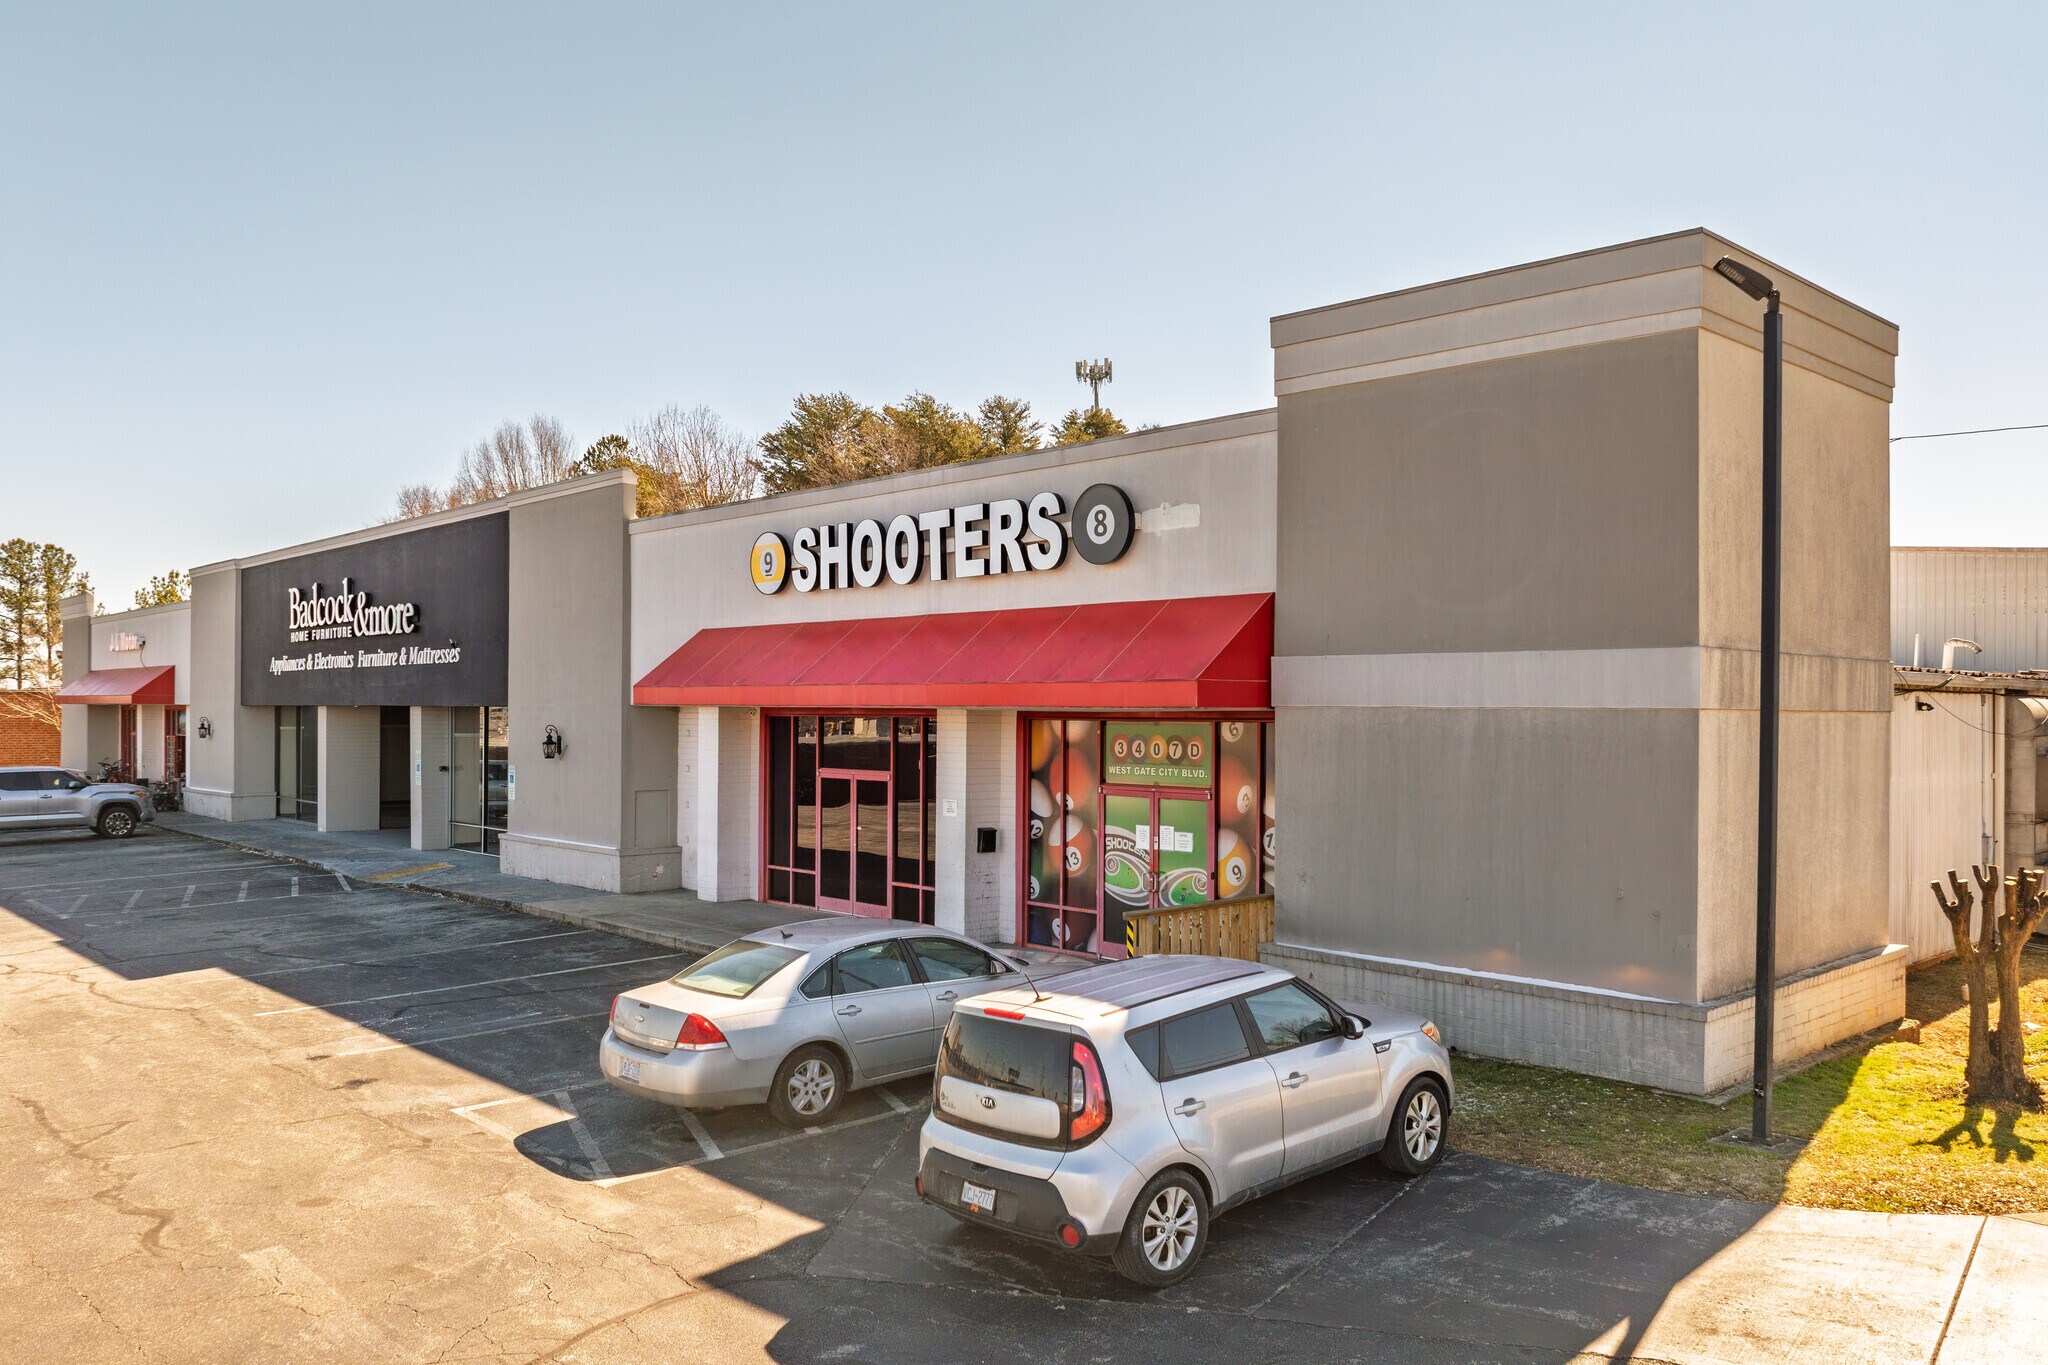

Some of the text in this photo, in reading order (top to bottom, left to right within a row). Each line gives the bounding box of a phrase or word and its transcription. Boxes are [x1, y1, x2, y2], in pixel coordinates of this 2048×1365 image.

[792, 492, 1068, 593] SHOOTERS
[288, 577, 415, 637] Badcock &more
[290, 626, 352, 642] HOME FURNITURE
[269, 646, 461, 676] Appliances & Electronics Furniture & Mattresses
[1108, 766, 1208, 778] WEST GATE CITY BLVD.
[981, 1097, 995, 1108] KIA
